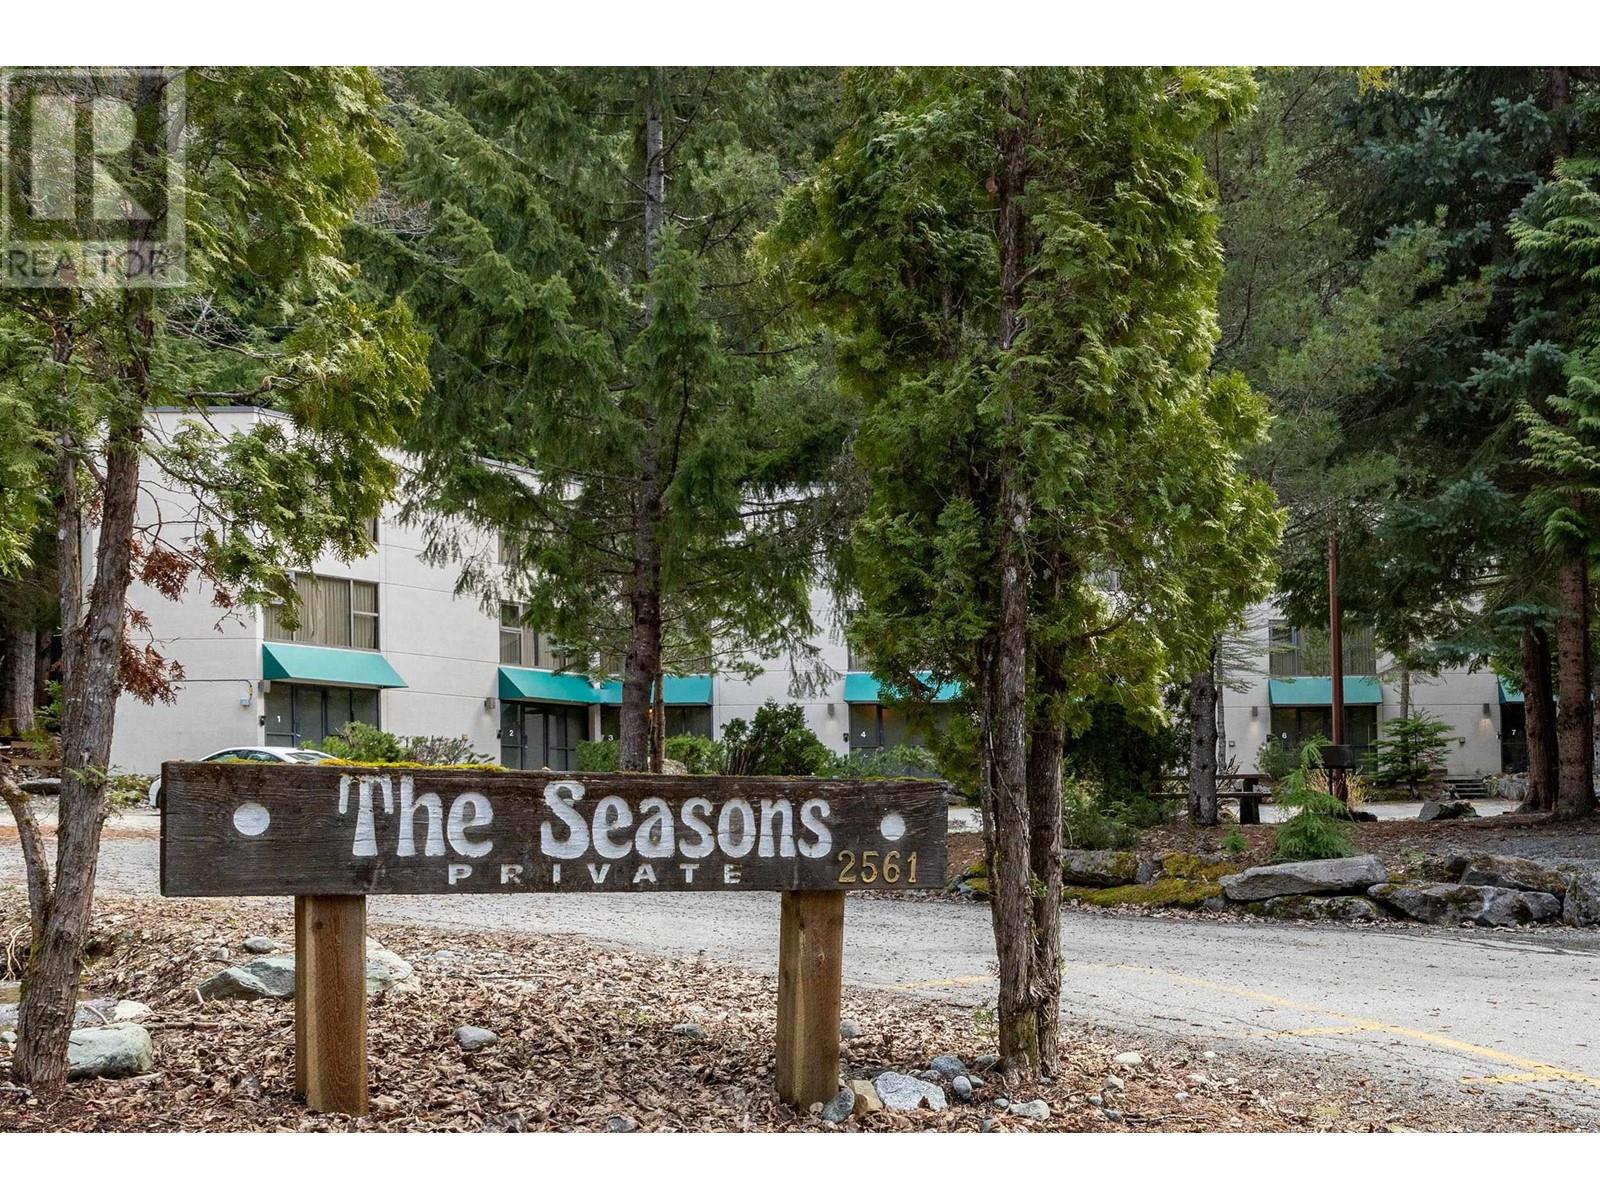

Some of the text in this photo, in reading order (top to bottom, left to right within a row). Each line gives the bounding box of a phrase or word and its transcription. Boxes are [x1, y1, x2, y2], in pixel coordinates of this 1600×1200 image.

[276, 715, 281, 723] 1
[509, 729, 514, 737] 2
[337, 773, 834, 860] The Seasons
[447, 862, 744, 886] PRIVATE
[837, 849, 919, 885] 2561
